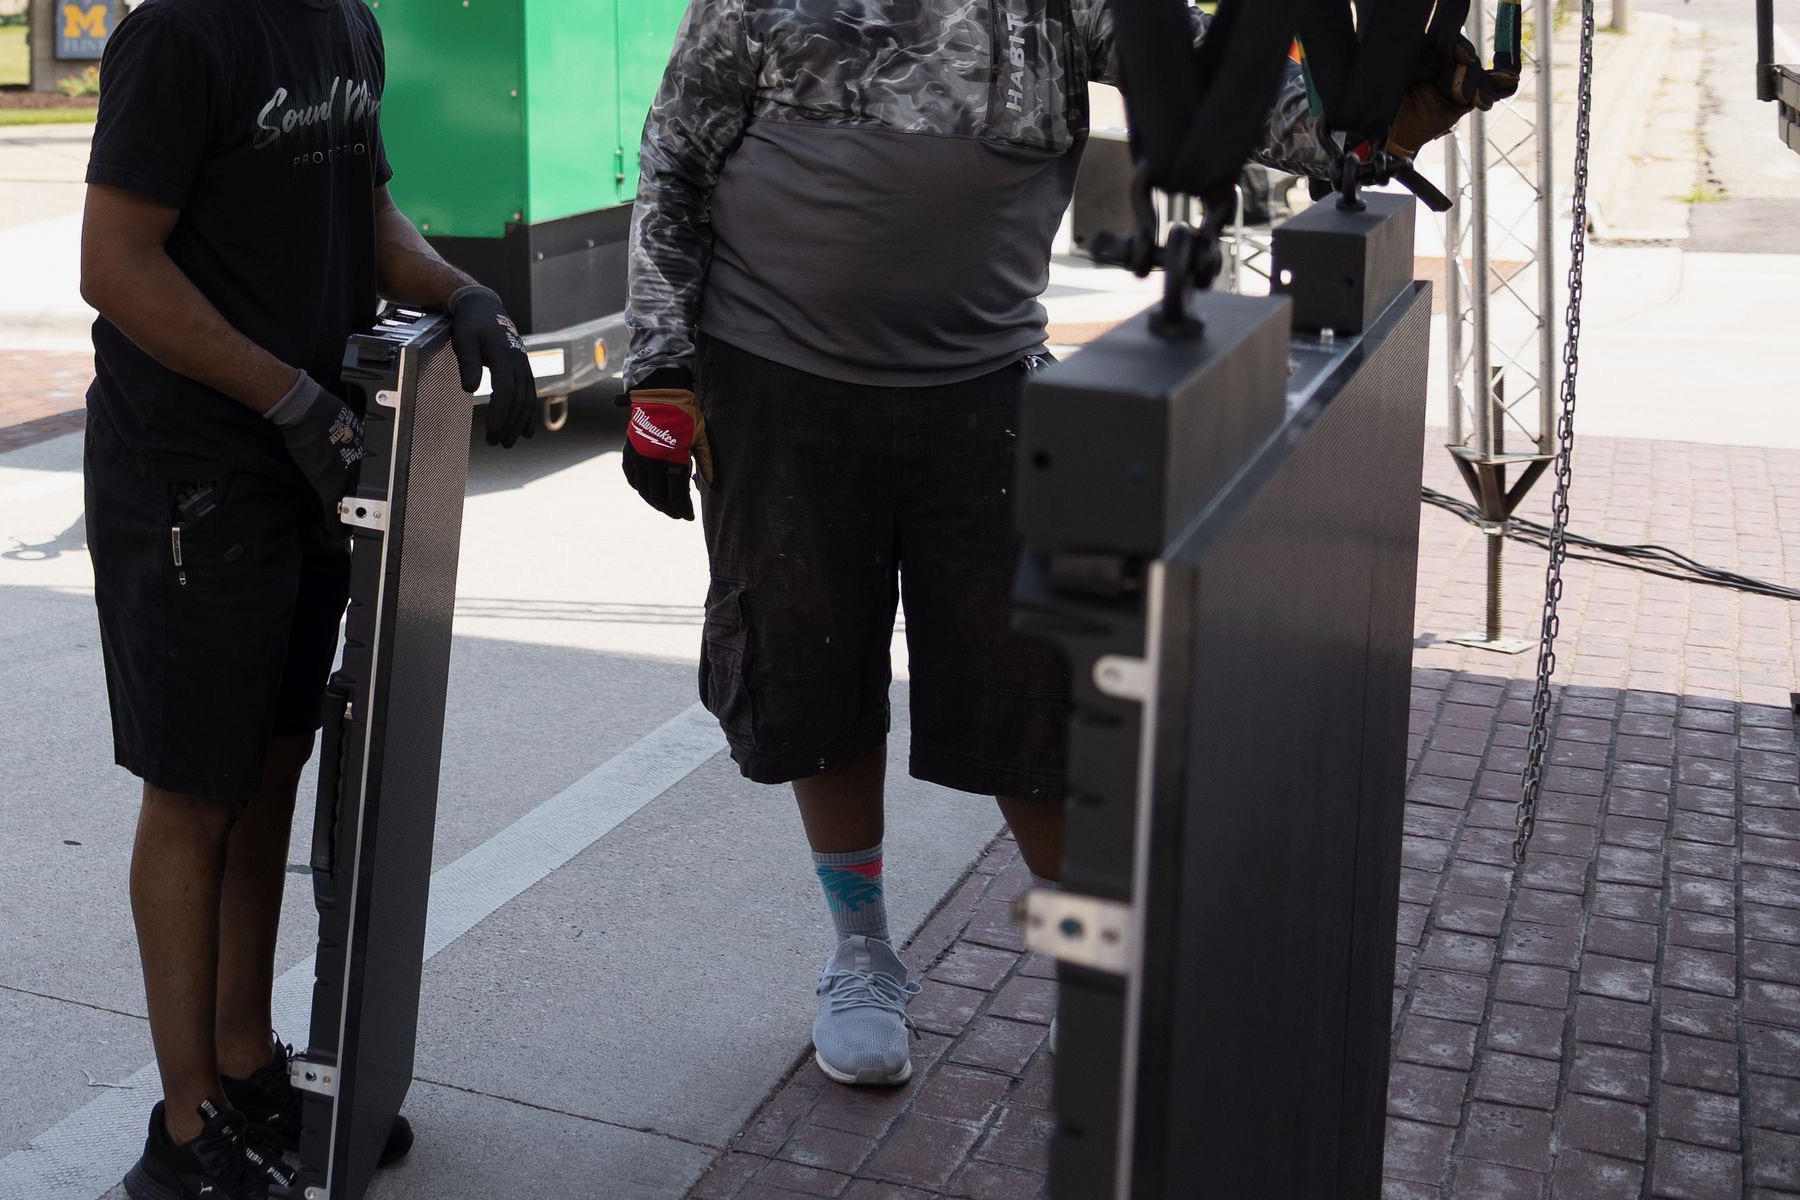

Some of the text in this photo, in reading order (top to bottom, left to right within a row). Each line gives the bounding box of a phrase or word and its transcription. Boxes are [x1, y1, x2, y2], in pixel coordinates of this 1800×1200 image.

[63, 4, 108, 39] M
[1005, 12, 1026, 113] HABIT
[253, 76, 382, 150] Sound Min
[632, 406, 678, 446] Milwaukee
